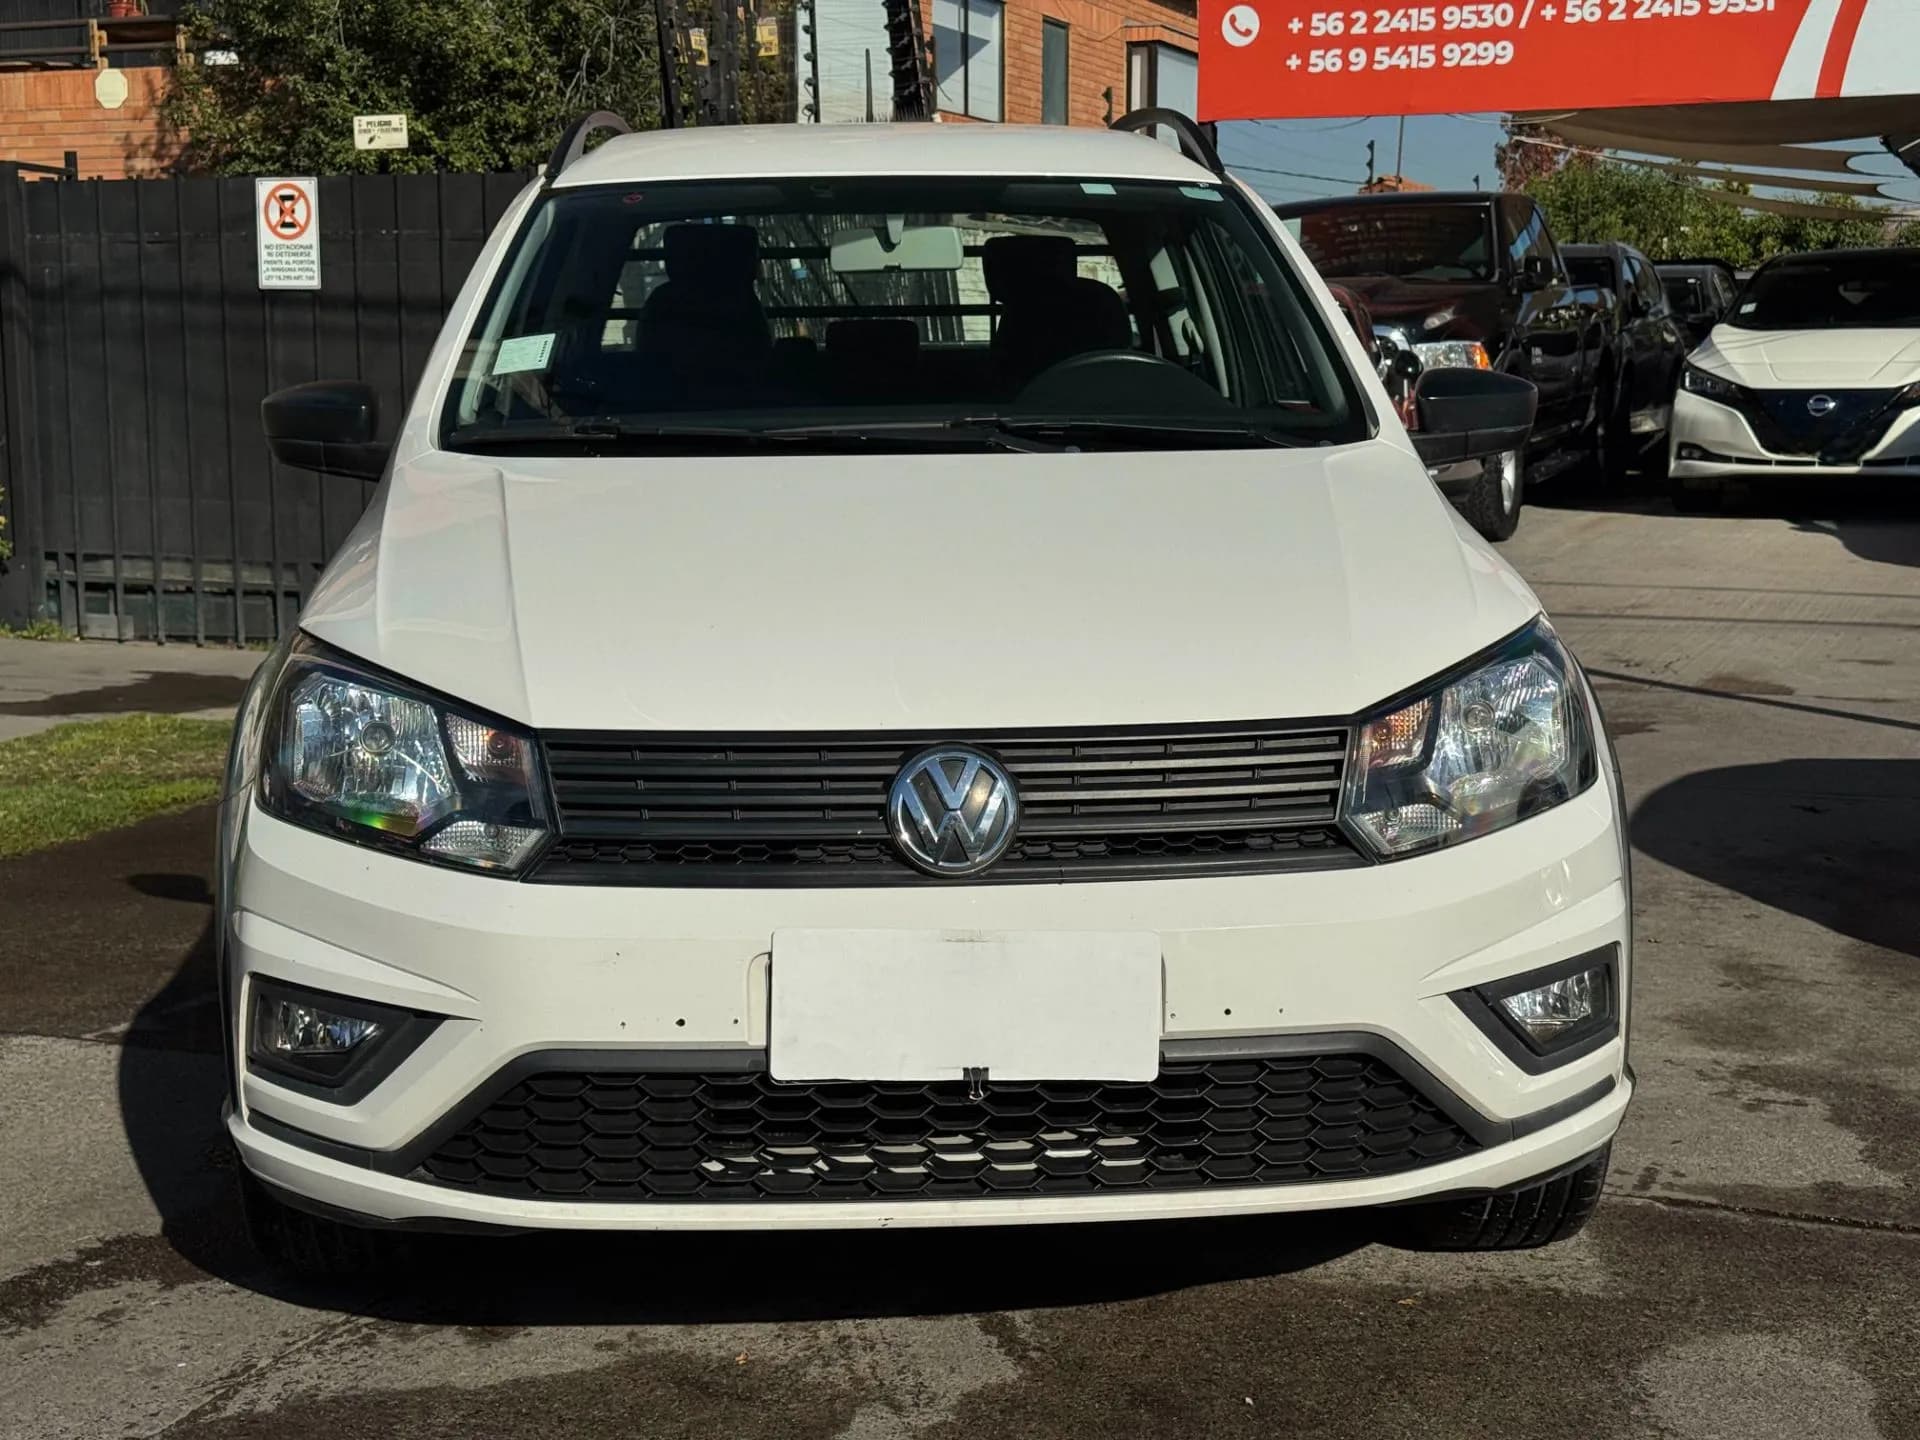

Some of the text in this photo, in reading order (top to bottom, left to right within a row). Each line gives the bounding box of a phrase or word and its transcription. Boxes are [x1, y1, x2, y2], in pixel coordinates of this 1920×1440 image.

[1287, 17, 1304, 34] +
[1309, 12, 1345, 36] 56
[1350, 11, 1368, 34] 2
[1373, 7, 1436, 33] 2415
[1442, 3, 1515, 30] 9530
[1540, 4, 1558, 21] +
[1563, 0, 1603, 23] 56
[1607, 0, 1627, 21] 2
[1632, 0, 1702, 19] 2415
[1285, 40, 1515, 73] + 56 9 5415 9299
